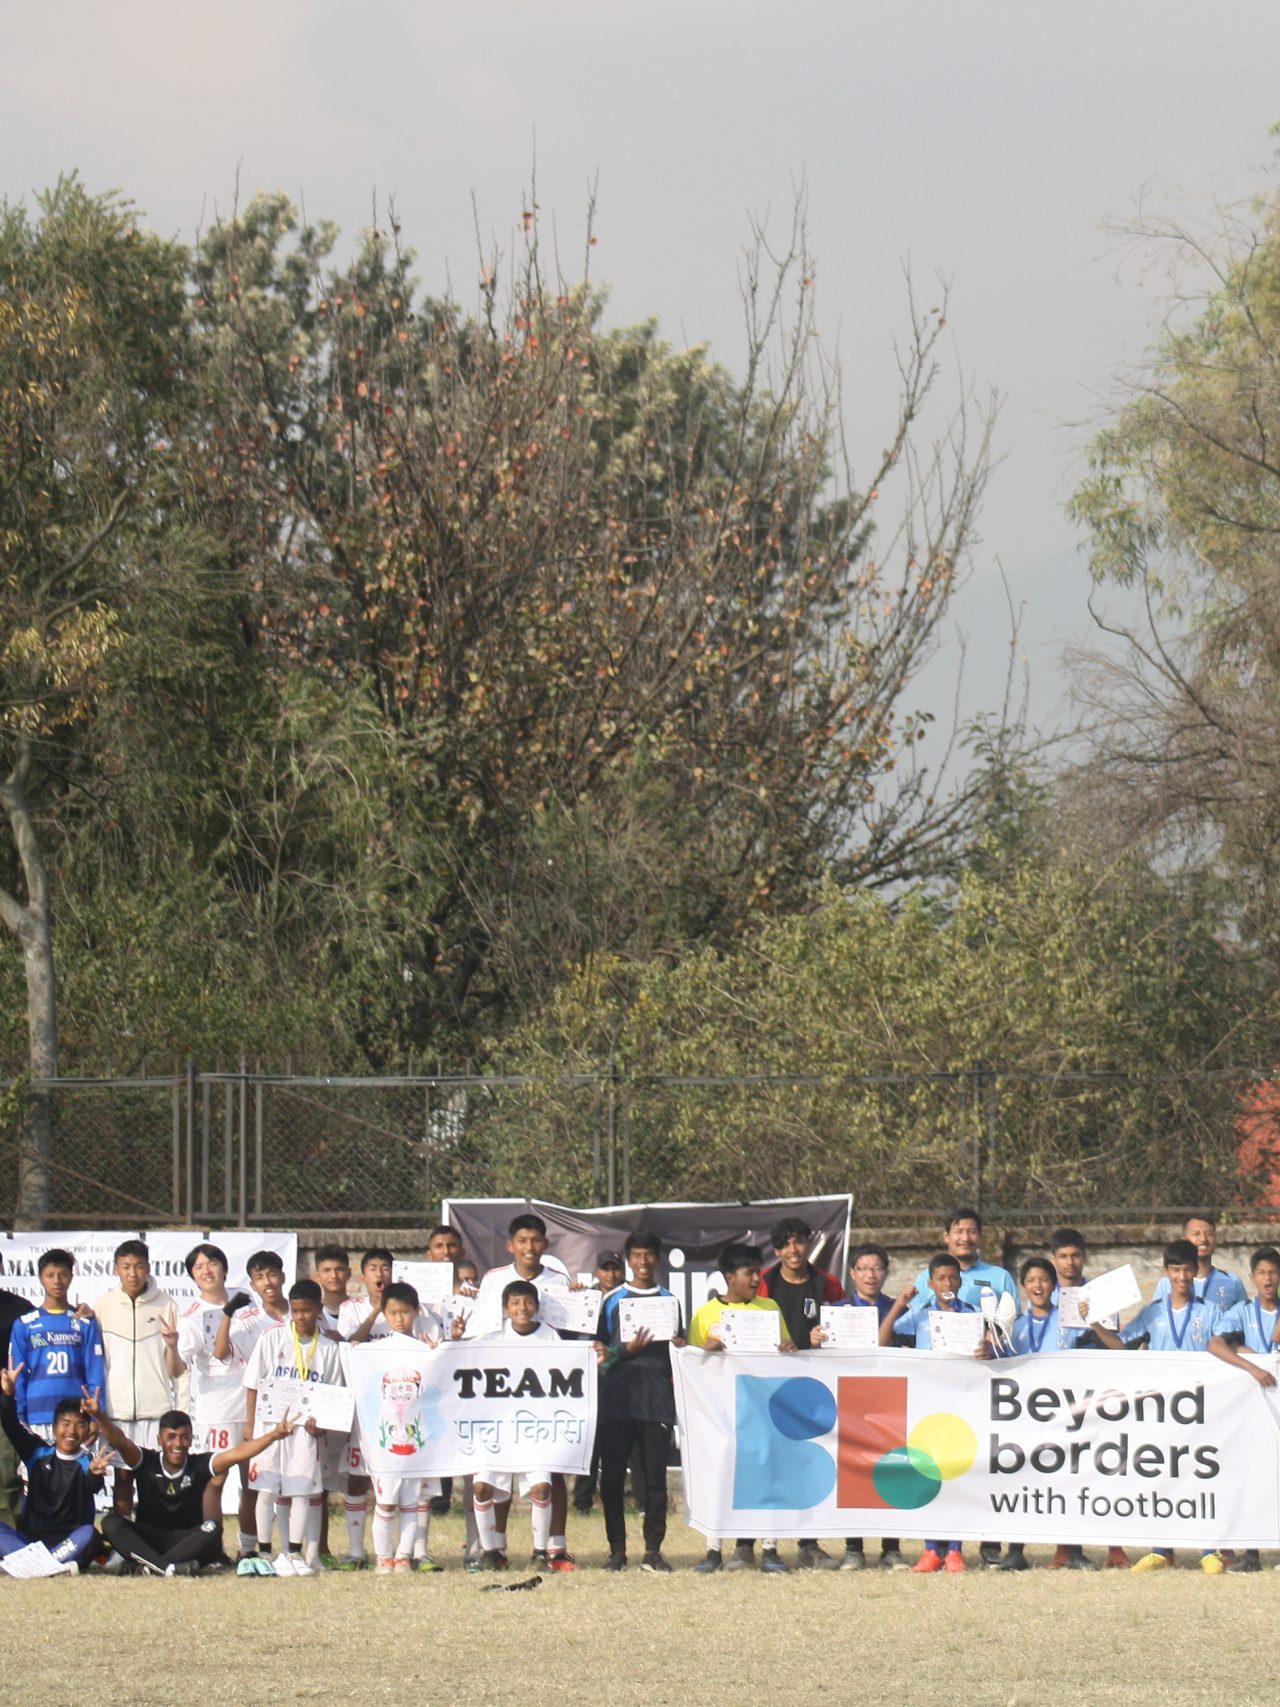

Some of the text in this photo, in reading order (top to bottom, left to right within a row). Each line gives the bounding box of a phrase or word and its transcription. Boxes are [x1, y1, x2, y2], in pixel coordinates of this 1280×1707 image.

[46, 1351, 69, 1375] 20
[453, 1367, 585, 1399] TEAM
[989, 1377, 1206, 1433] Beyond
[210, 1429, 229, 1449] 18
[989, 1432, 1221, 1480] borders
[989, 1486, 1216, 1520] with football
